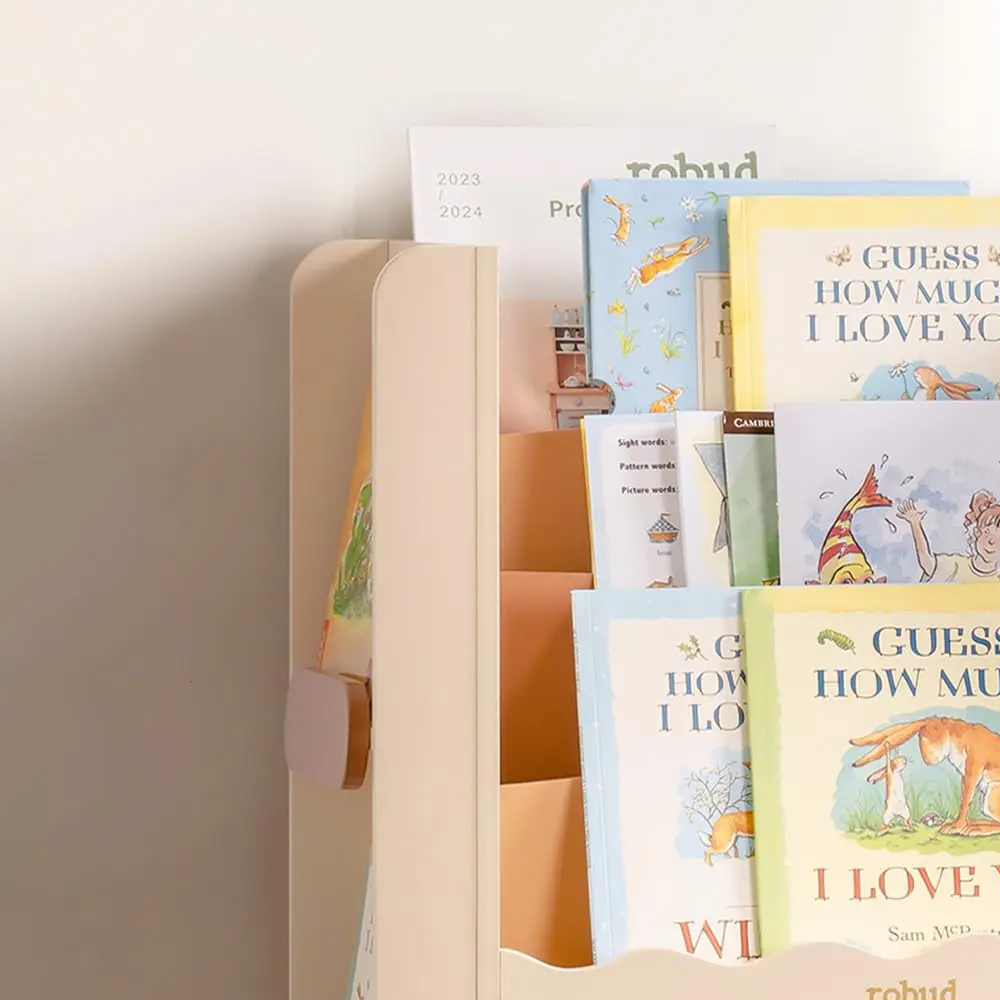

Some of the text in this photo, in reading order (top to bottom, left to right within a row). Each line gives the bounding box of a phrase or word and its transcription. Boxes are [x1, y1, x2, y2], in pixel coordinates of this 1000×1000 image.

[437, 171, 481, 186] 2023
[439, 204, 483, 219] 2024
[862, 244, 981, 270] GUESS
[813, 279, 905, 306] HOW
[806, 313, 820, 343] I
[834, 313, 945, 344] LOVE
[617, 438, 639, 448] Sight
[619, 462, 649, 470] Pattern
[621, 486, 649, 494] Picture
[714, 633, 744, 660] G
[813, 667, 925, 699] HOW
[657, 701, 747, 732] I LO
[813, 867, 830, 902] I
[848, 866, 981, 902] LOVE
[672, 919, 761, 960] WI
[888, 925, 925, 942] Sam
